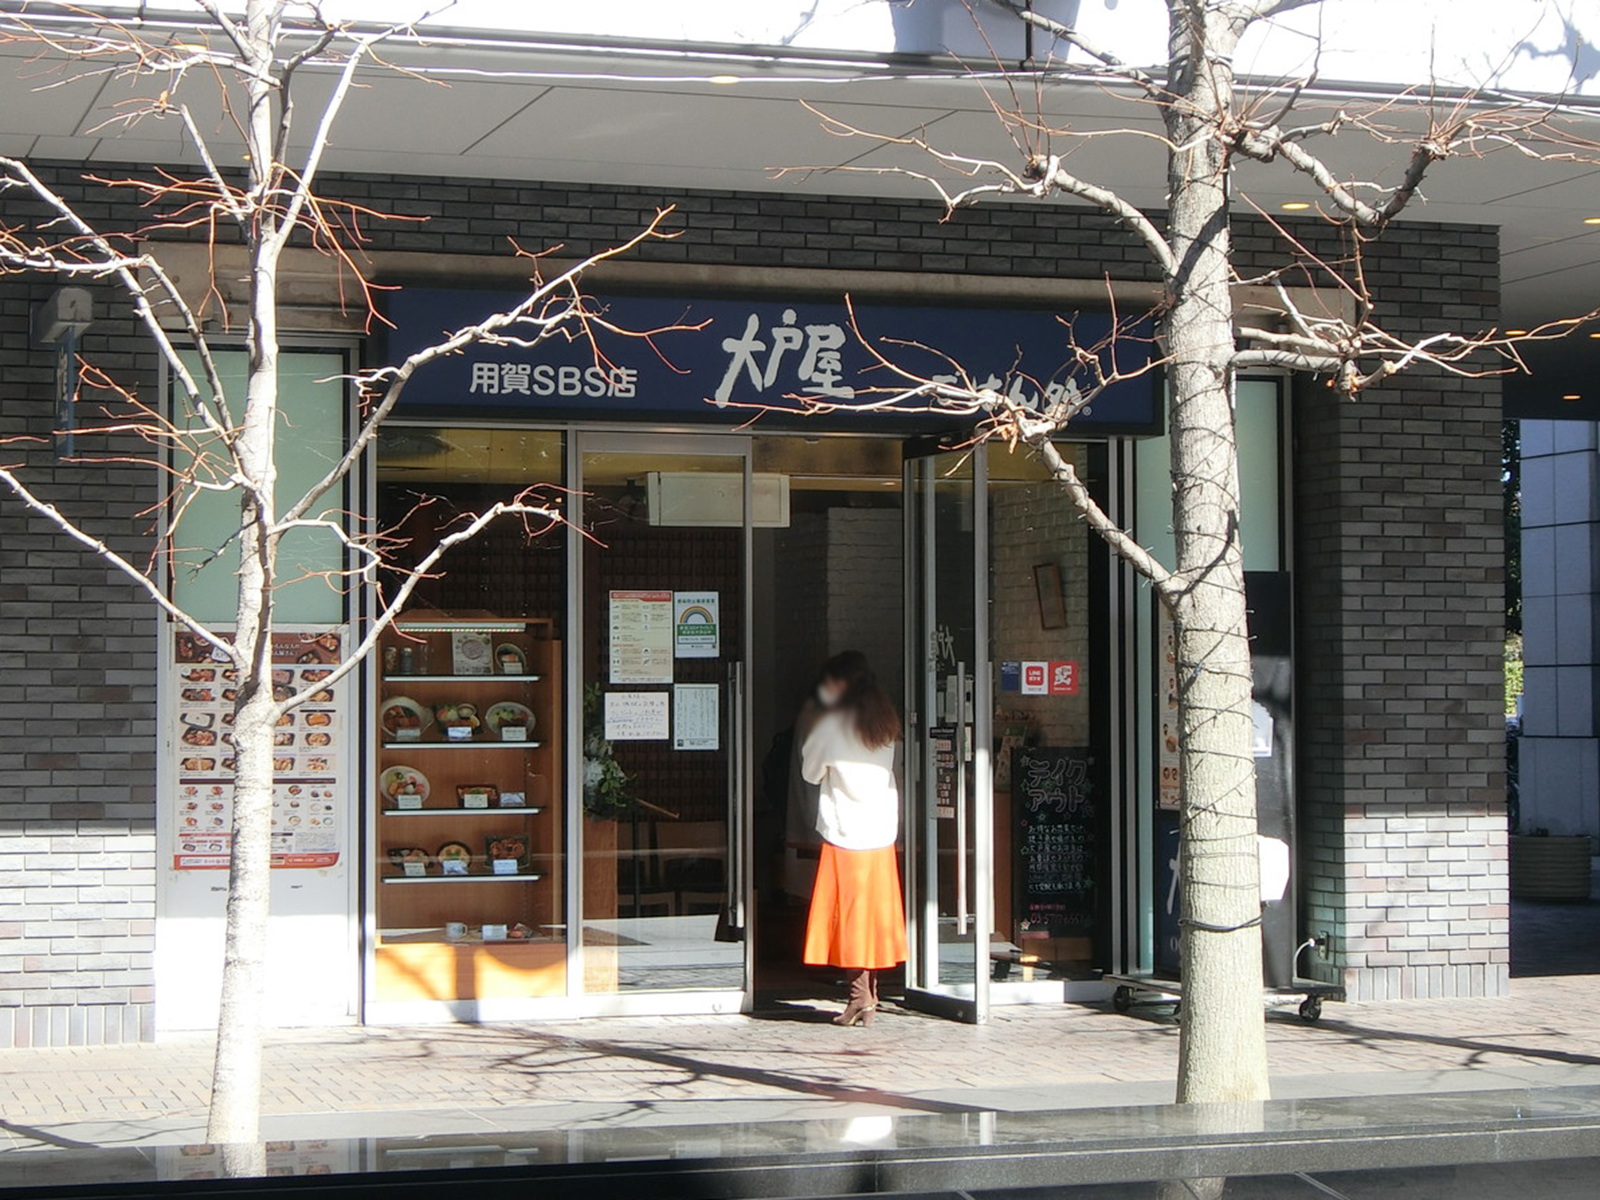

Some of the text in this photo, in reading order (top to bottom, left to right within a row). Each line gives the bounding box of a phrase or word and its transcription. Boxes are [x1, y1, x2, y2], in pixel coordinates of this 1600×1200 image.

[715, 309, 855, 409] 大戸屋
[470, 362, 638, 398] 用賀SBS店
[1028, 758, 1087, 788] テイク
[1028, 785, 1086, 813] アウト
